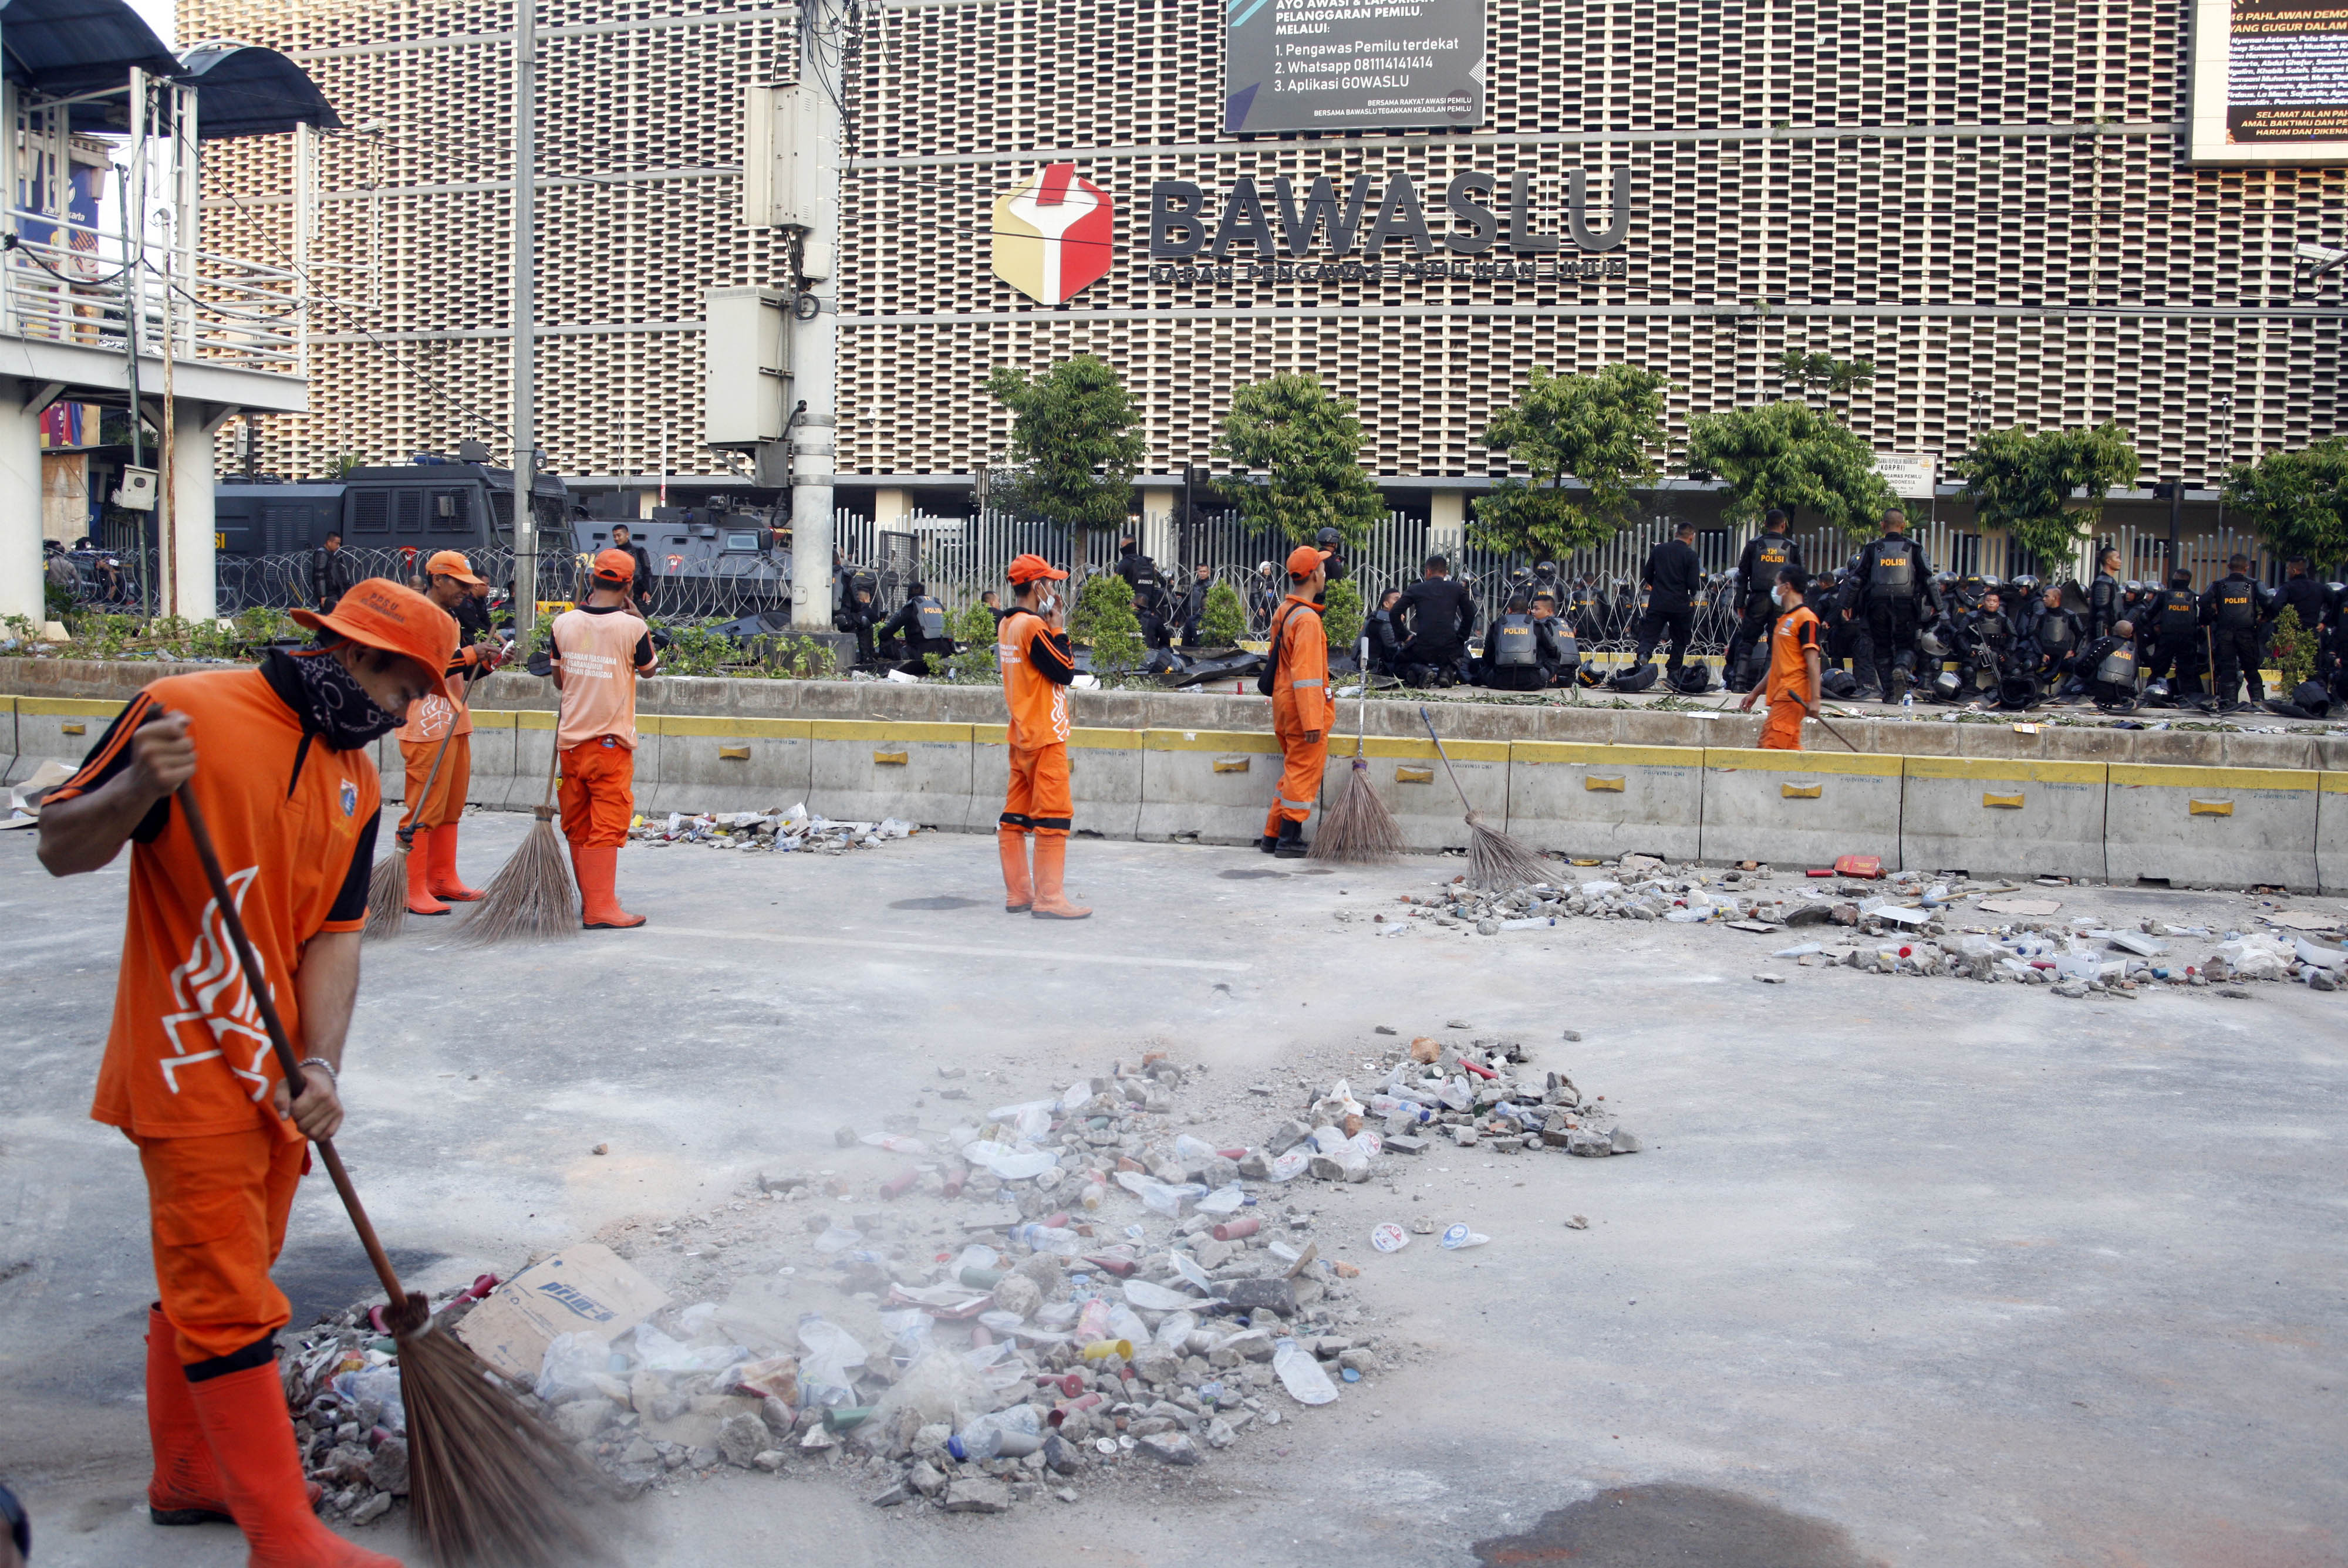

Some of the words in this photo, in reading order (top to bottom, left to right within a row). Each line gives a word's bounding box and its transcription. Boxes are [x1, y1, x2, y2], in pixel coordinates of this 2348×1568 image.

[1276, 0, 1303, 10] AYO
[1276, 8, 1371, 22] PELANGGARAN
[2246, 11, 2312, 21] PAHLAWAN
[1275, 23, 1330, 35] MELALUI:
[2262, 22, 2302, 32] GUGUR
[2305, 21, 2347, 31] DALAM
[1275, 45, 1283, 56] 1.
[1286, 43, 1352, 58] Pengawas
[1355, 39, 1400, 53] Pemilu
[1403, 38, 1459, 52] terdekat
[1274, 62, 1285, 74] 2.
[1287, 60, 1350, 75] Whatsapp
[1354, 56, 1433, 71] 081114141414
[1274, 79, 1284, 92] 3.
[1287, 78, 1338, 93] Aplikasi
[1341, 75, 1409, 89] GOWASLU
[2255, 110, 2300, 119] SELAMAT
[2301, 110, 2330, 119] JALAN
[1149, 168, 1632, 258] BAWASLU
[1149, 265, 1233, 283] BADAN
[1246, 263, 1385, 281] PENGAWAS
[1398, 261, 1537, 279] PEMILIHAN
[1553, 259, 1629, 277] UMUM
[1761, 555, 1784, 563] POLISI
